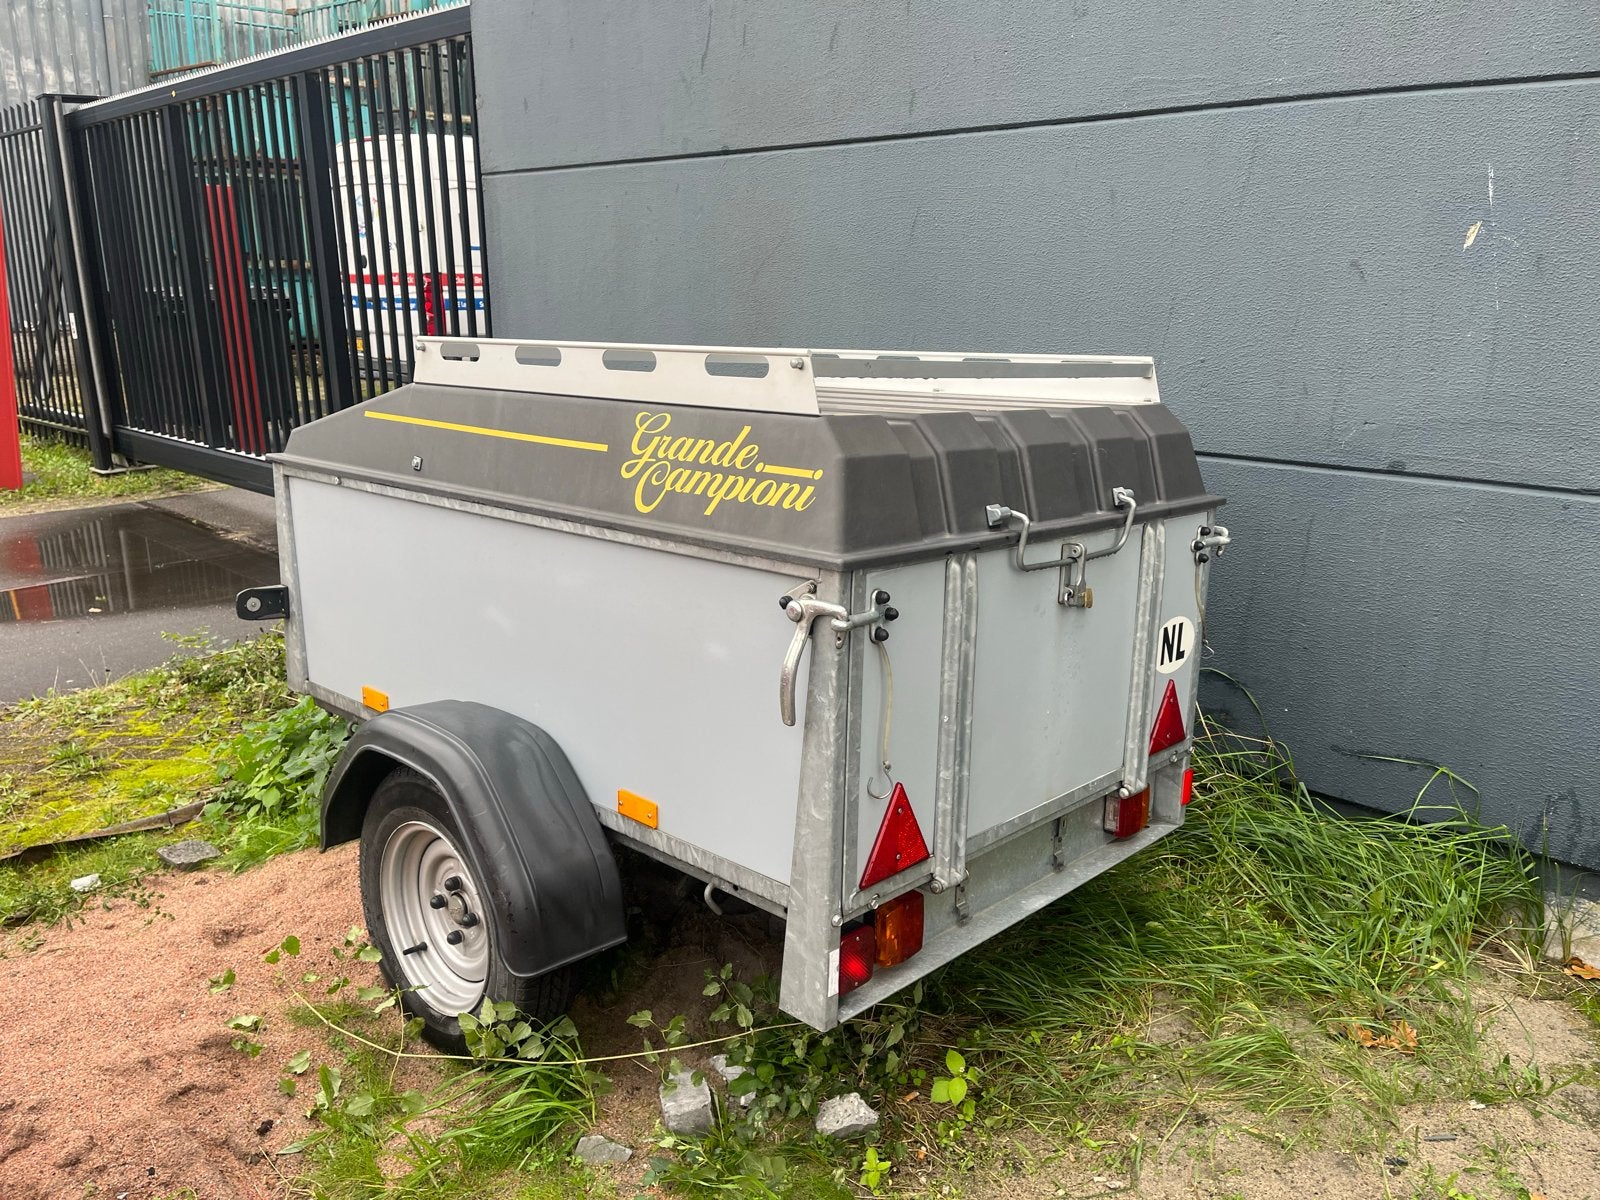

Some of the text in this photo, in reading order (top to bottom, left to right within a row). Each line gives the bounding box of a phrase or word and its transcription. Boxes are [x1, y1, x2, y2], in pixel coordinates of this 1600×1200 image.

[620, 411, 759, 479] Grande
[634, 461, 823, 516] Campioni
[1160, 622, 1185, 666] NL
